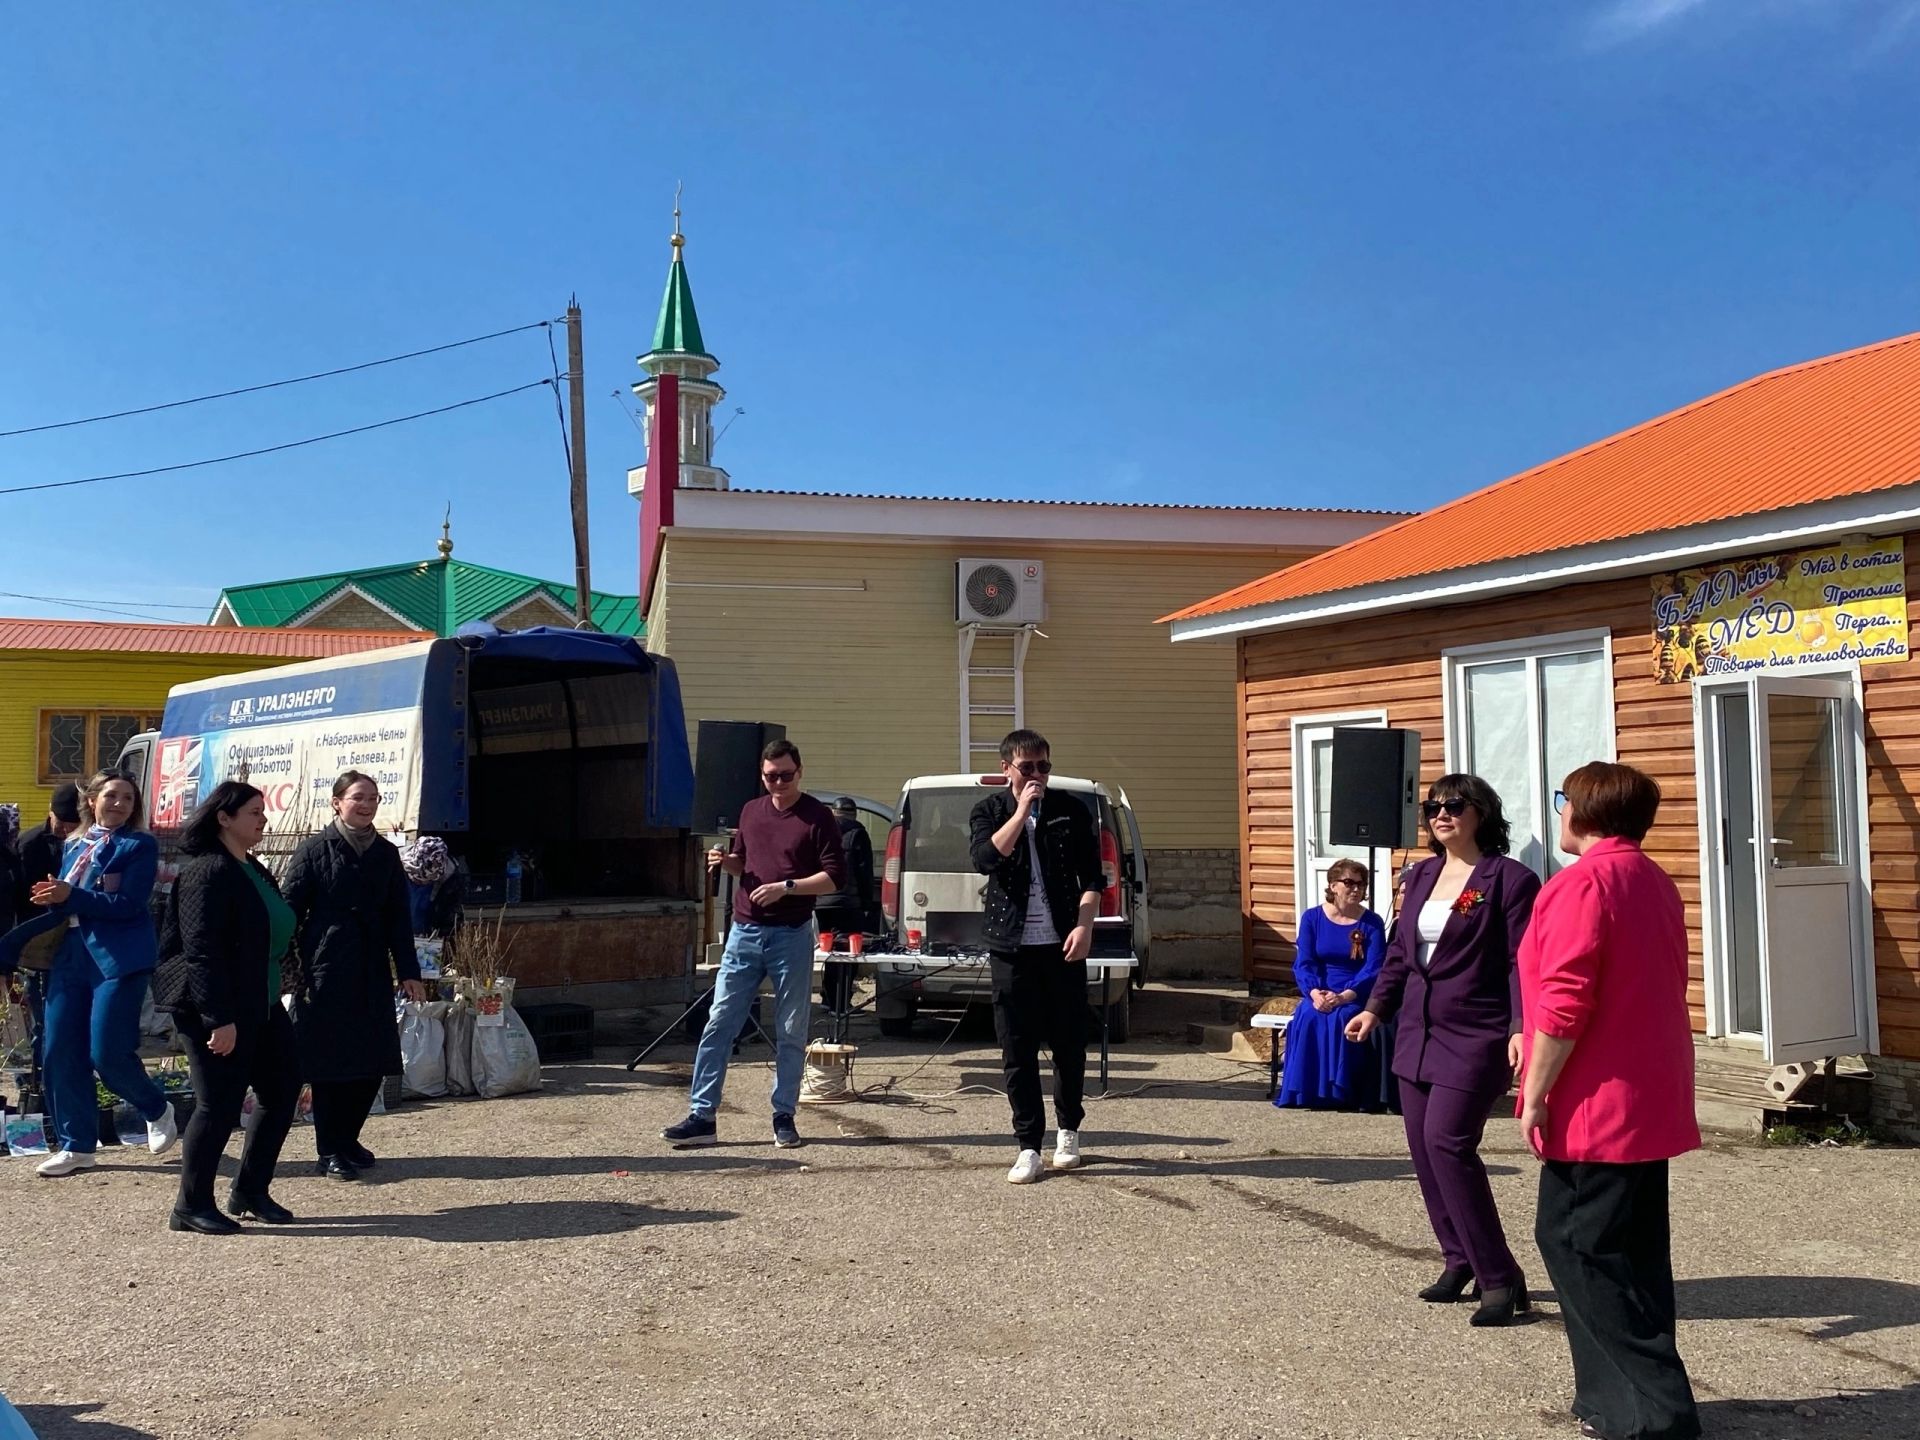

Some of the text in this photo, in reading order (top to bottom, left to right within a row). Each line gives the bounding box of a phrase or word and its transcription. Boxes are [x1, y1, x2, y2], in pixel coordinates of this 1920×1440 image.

[1801, 551, 1903, 576] Мёд в сотах
[1823, 583, 1903, 606] Прополис
[1709, 596, 1795, 651] МЁД
[1706, 637, 1906, 673] Товары для пчеловодства
[256, 686, 336, 712] УРАЛЭНЕРГО
[379, 728, 407, 741] Челны
[229, 739, 294, 760] Официальный
